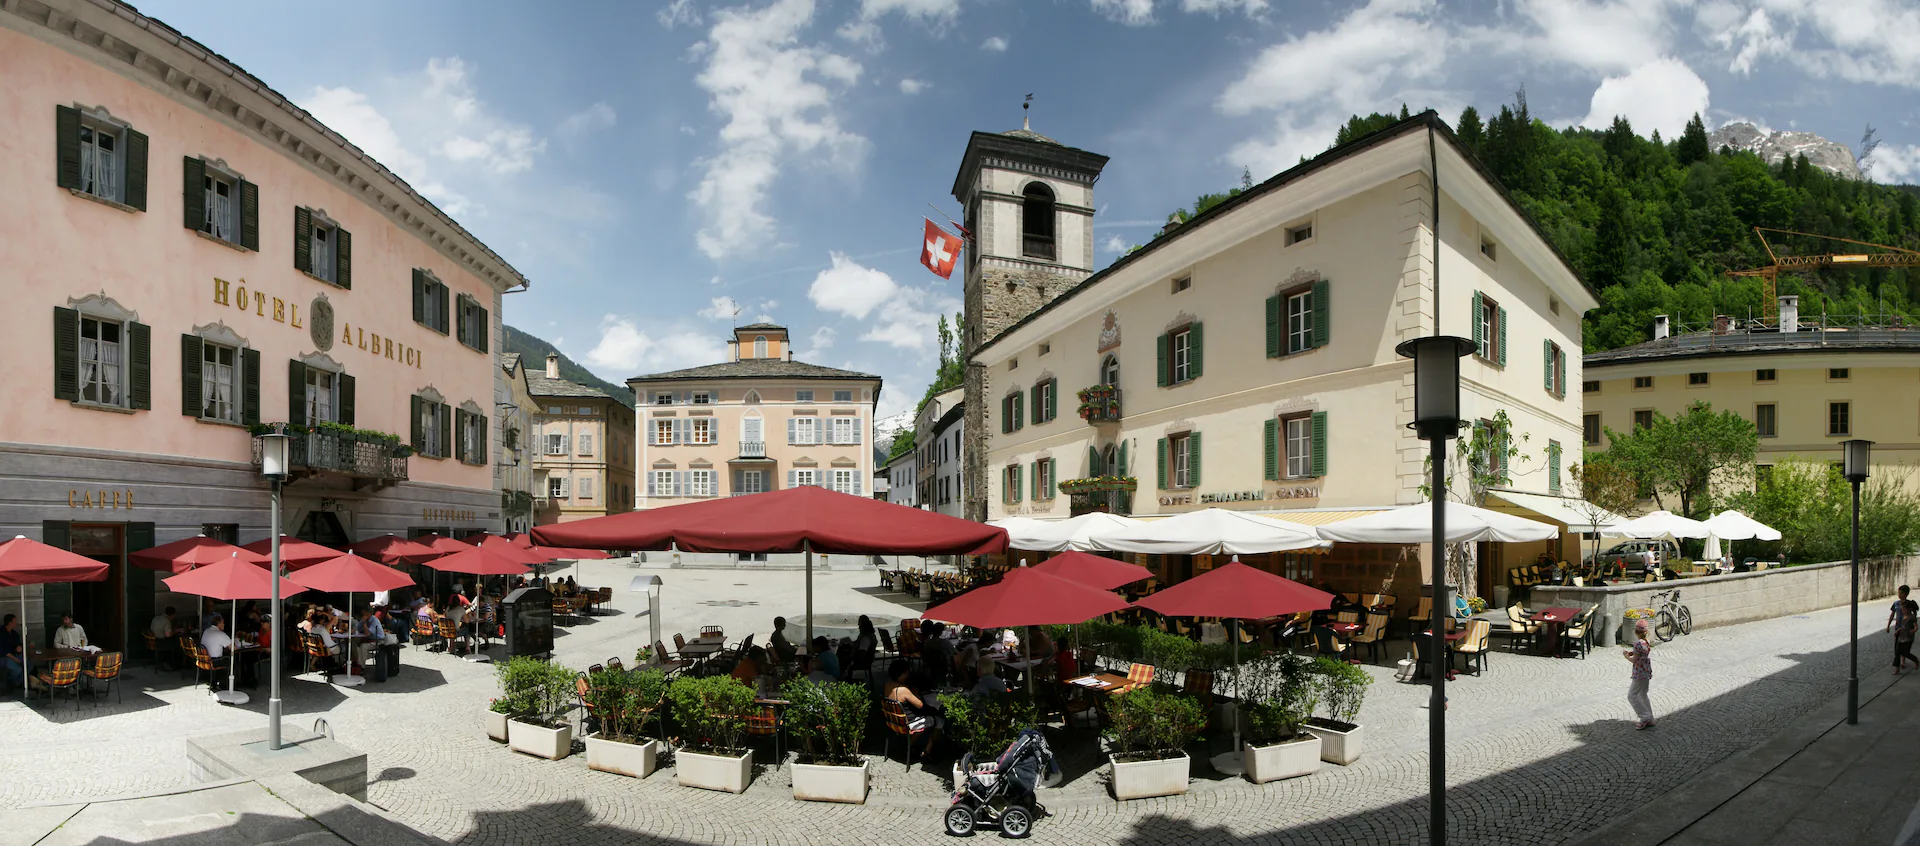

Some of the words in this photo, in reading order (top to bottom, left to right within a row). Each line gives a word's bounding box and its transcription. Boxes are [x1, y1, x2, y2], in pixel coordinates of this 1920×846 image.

[213, 277, 303, 329] HÔTEL
[342, 322, 422, 369] ALBRICI
[69, 488, 134, 509] CAFFÈ
[1201, 488, 1265, 504] SEMADENI
[1276, 486, 1321, 499] GARNI
[423, 508, 477, 521] RISTORANTE
